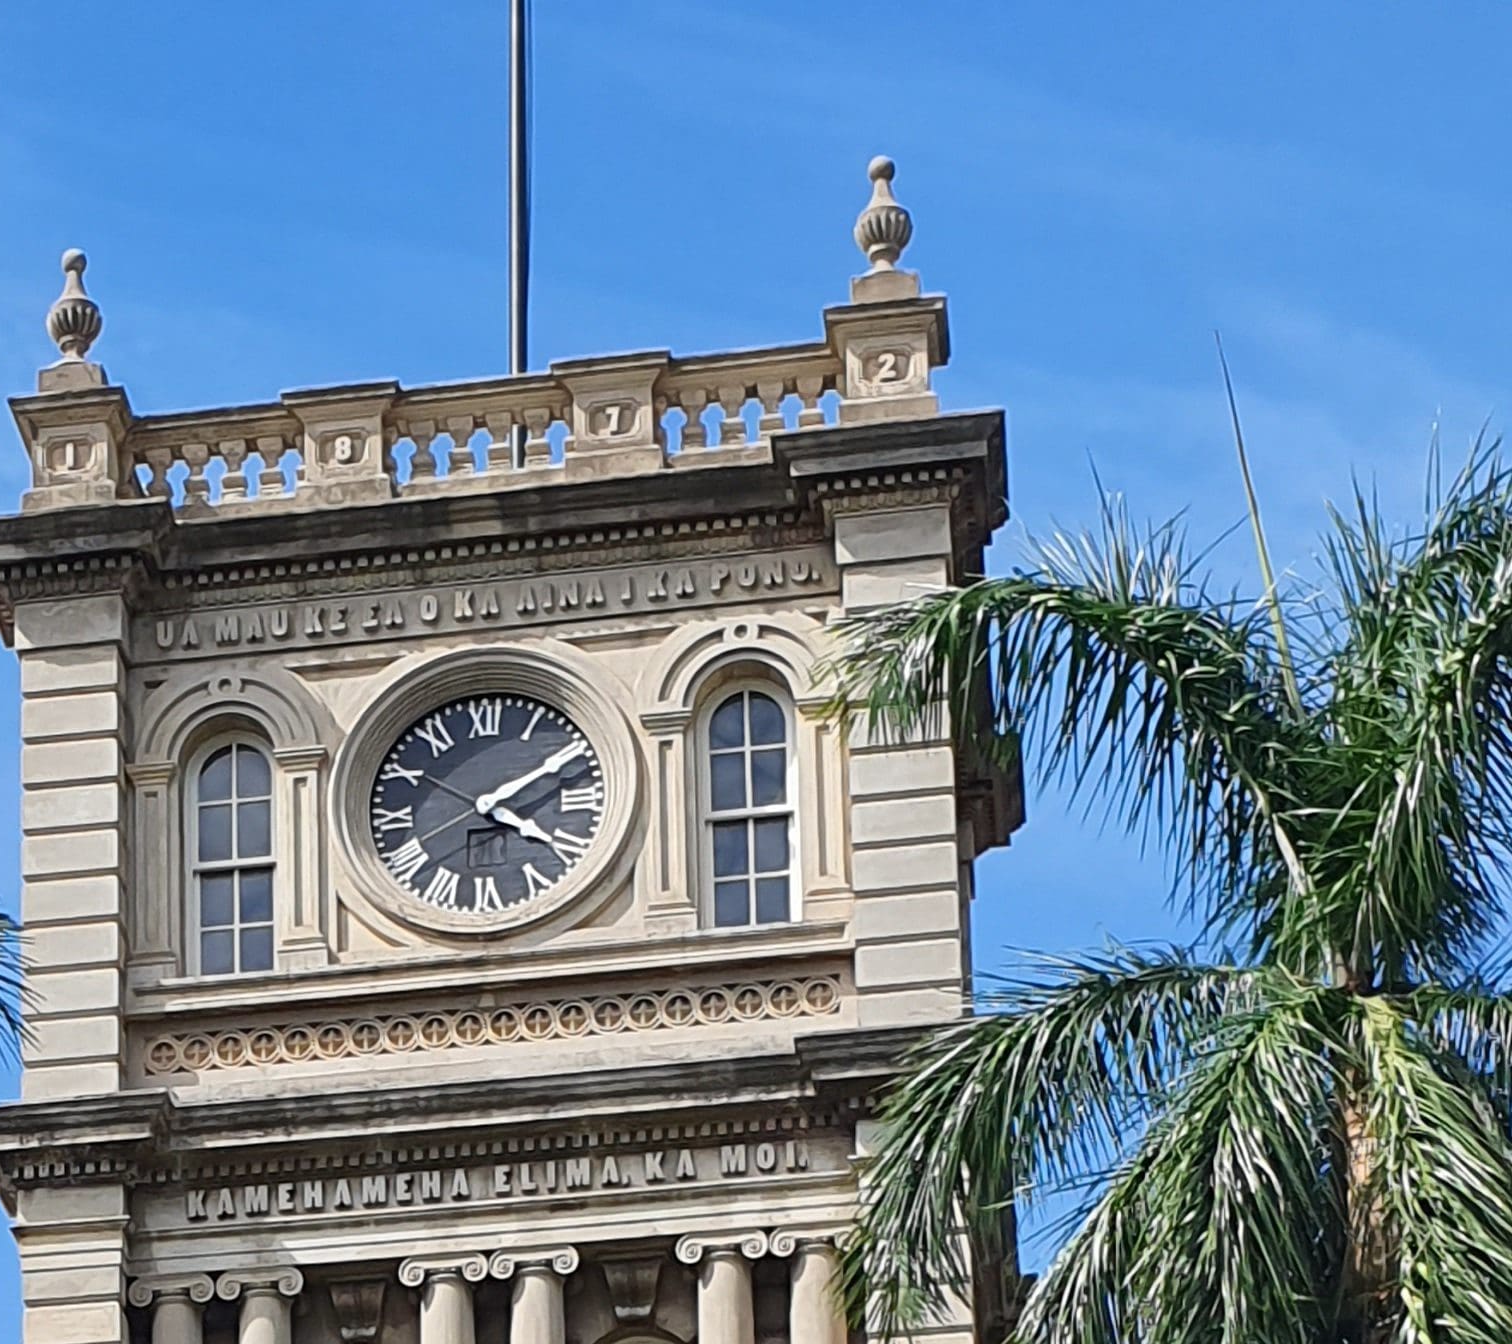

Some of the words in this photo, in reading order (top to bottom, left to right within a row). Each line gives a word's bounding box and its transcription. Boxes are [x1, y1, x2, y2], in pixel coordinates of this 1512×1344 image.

[334, 435, 352, 461] 8
[604, 406, 622, 433] 7
[877, 353, 897, 380] 2
[156, 619, 199, 648] UA
[215, 608, 289, 644] MAU
[305, 606, 347, 635] KE
[361, 600, 404, 631] EA
[419, 595, 438, 622] O
[453, 589, 501, 621] KA
[517, 576, 605, 612] AINA
[647, 569, 696, 597] KA
[188, 1168, 470, 1219] KAMEHAMEHA
[644, 1149, 695, 1180] KA
